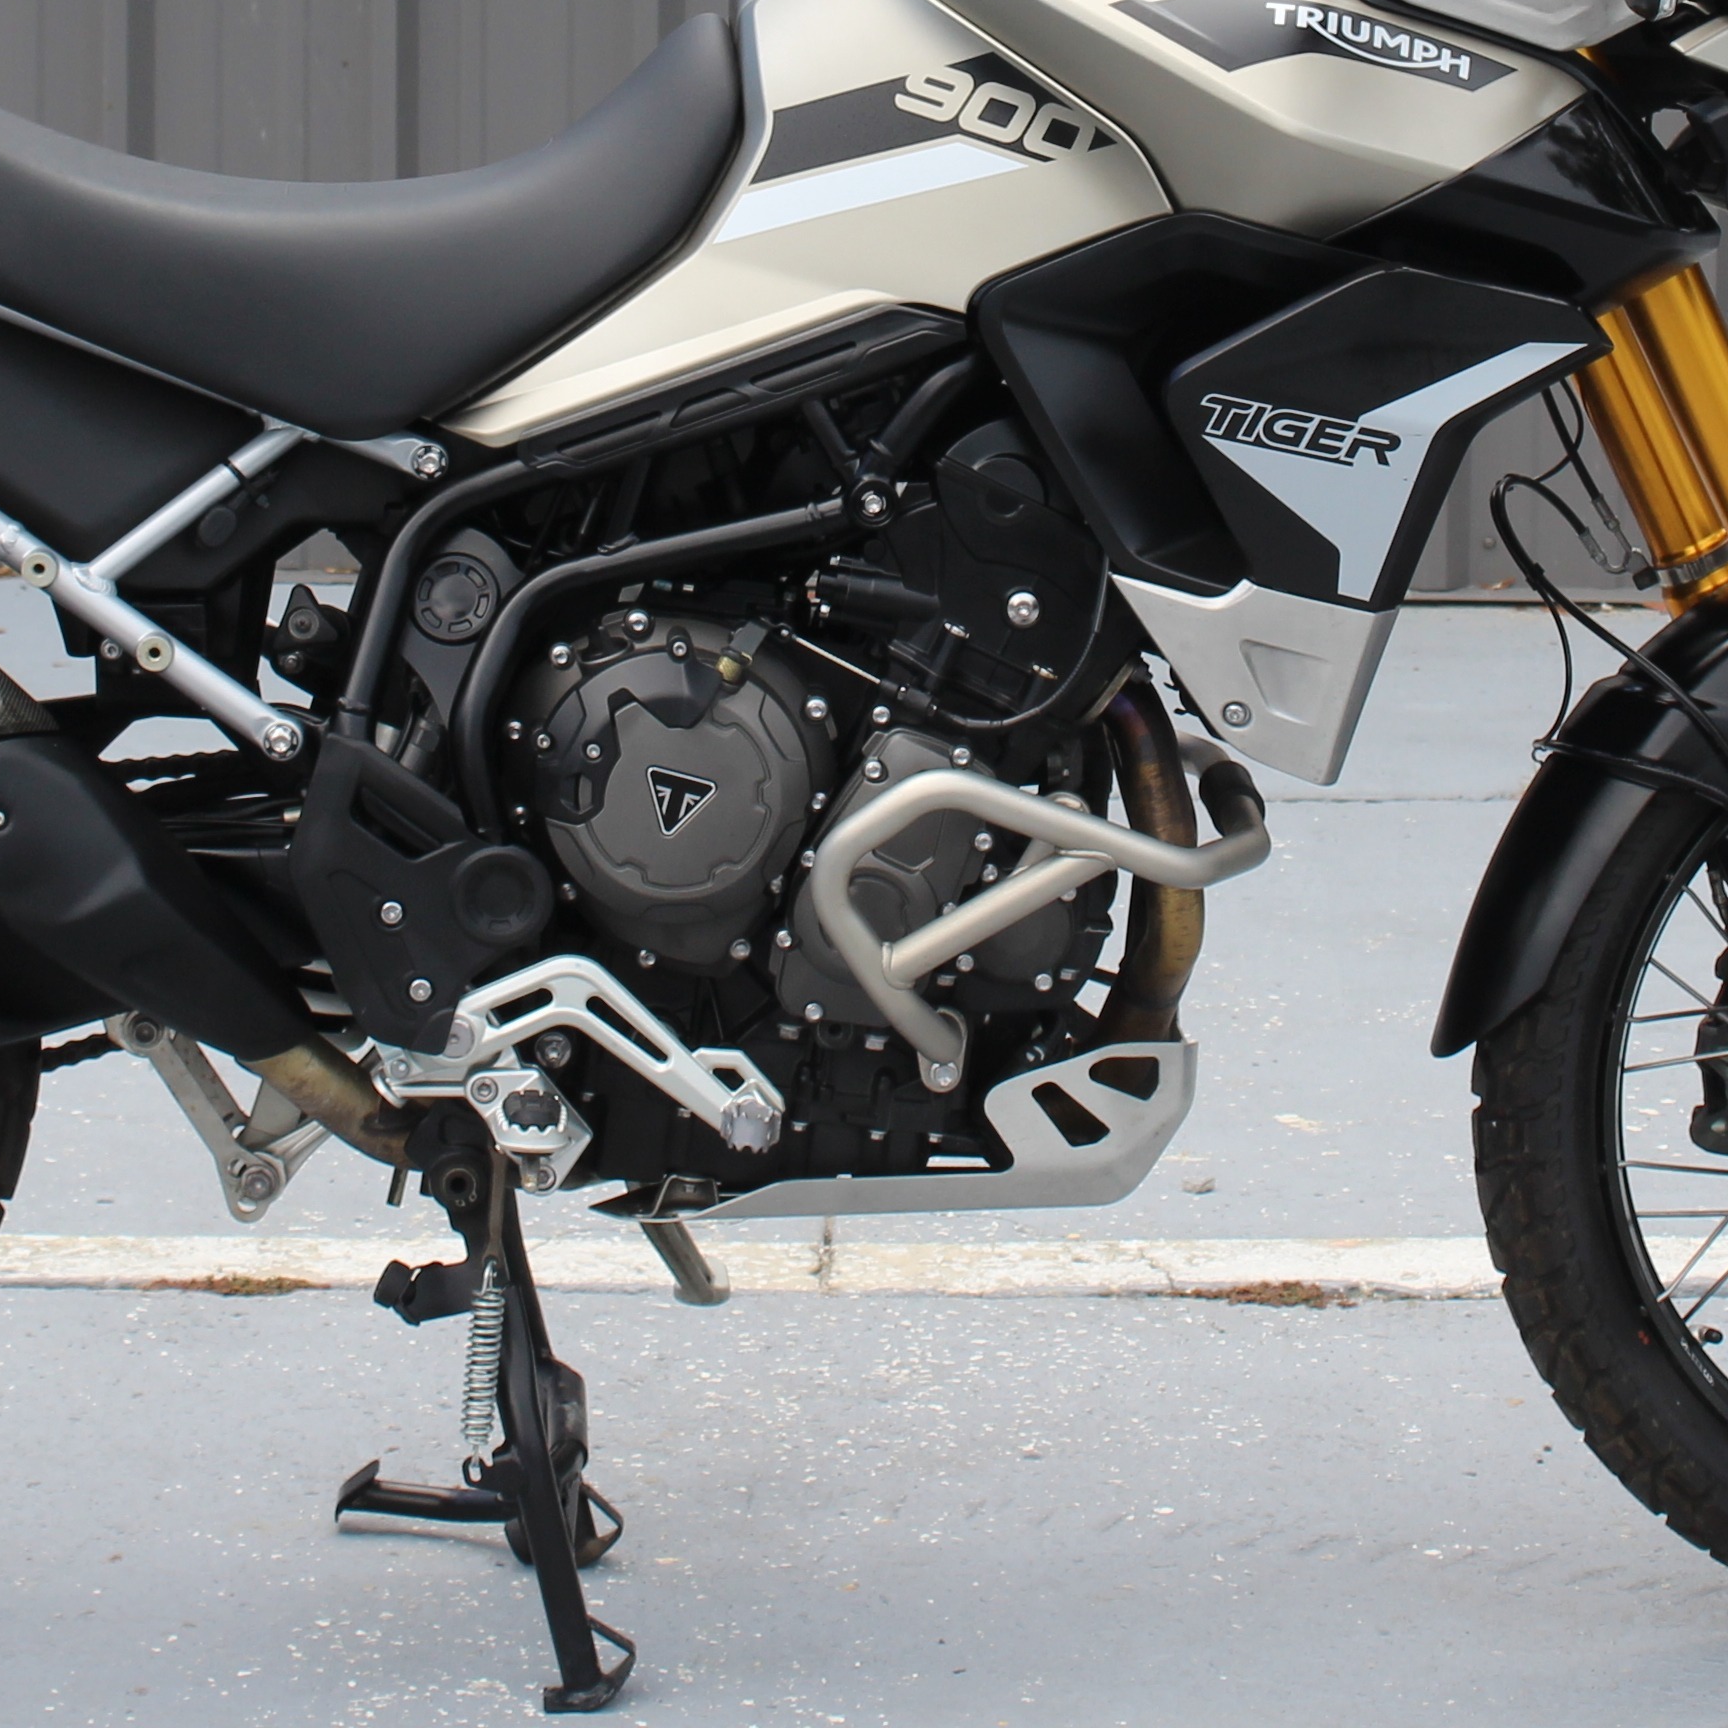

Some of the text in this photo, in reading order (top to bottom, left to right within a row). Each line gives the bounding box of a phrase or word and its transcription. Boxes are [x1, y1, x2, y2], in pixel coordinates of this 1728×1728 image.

[1266, 2, 1471, 81] TRIUMPH
[894, 69, 1096, 160] 900
[1200, 393, 1403, 468] TIGER
